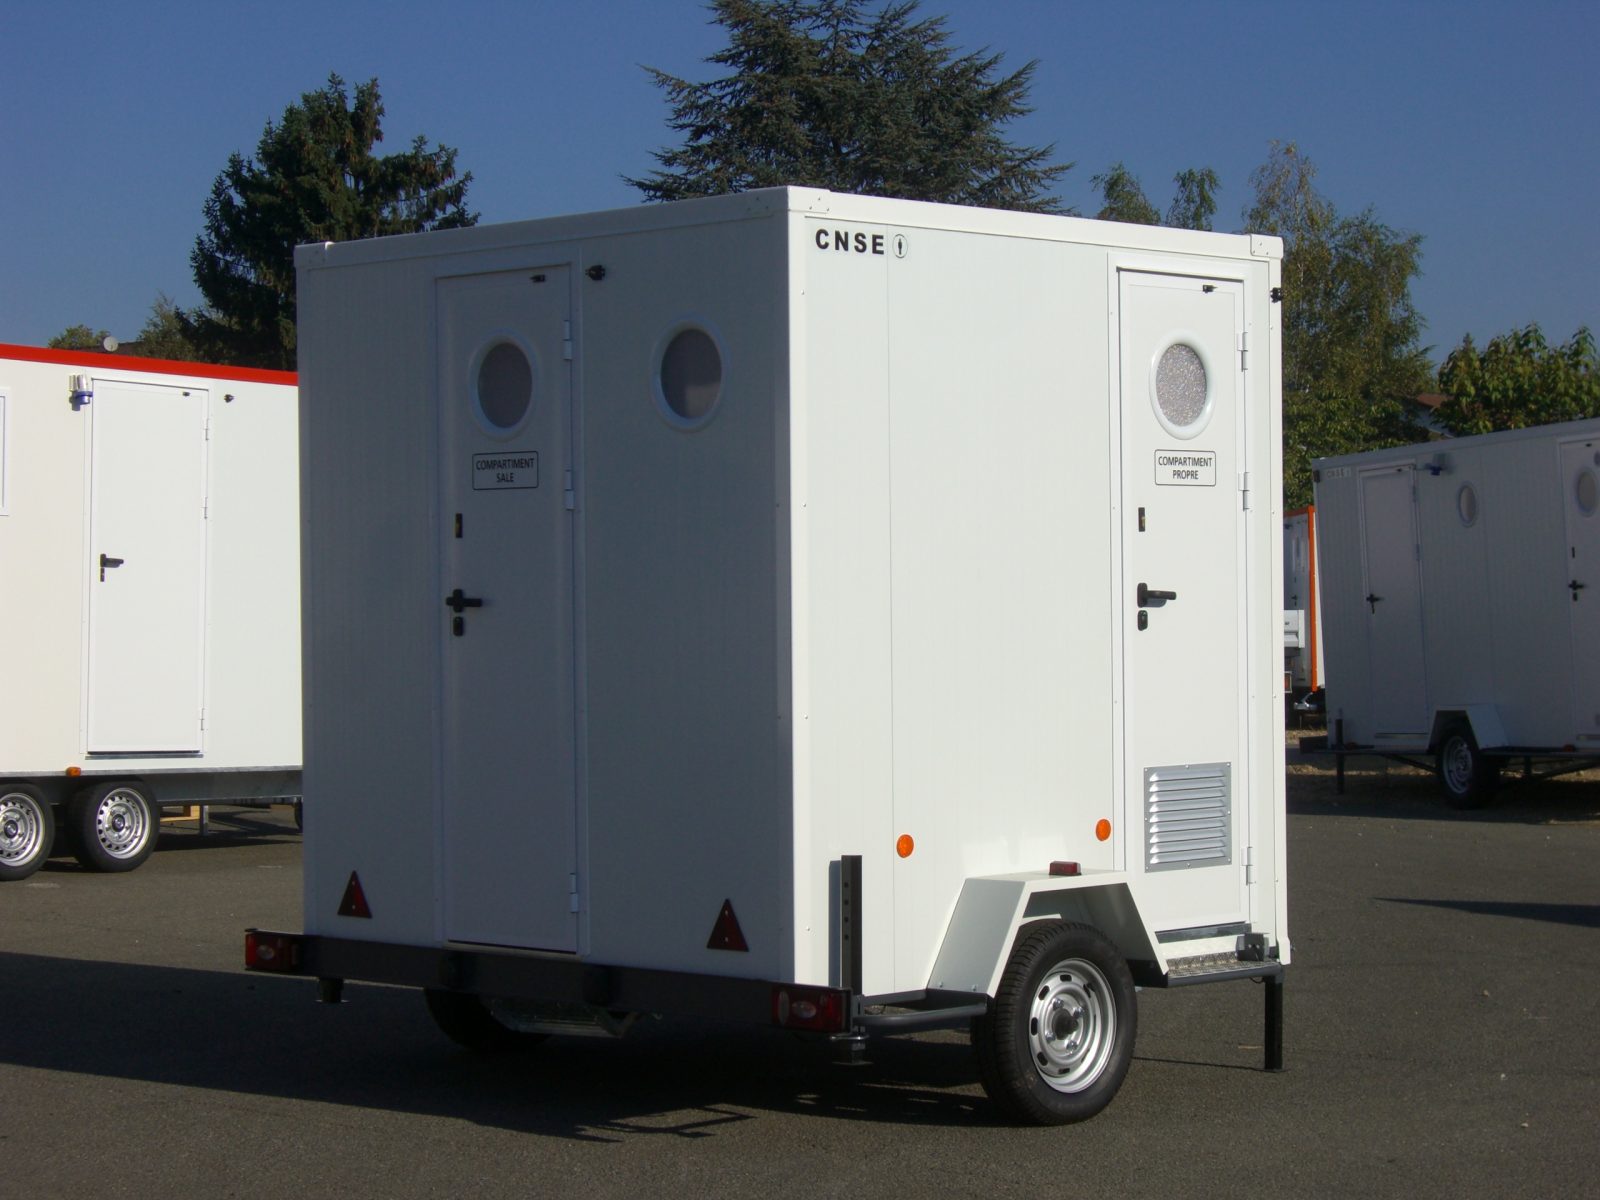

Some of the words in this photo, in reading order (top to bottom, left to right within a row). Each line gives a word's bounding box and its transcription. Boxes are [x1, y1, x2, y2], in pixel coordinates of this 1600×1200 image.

[815, 228, 884, 255] CNSE
[475, 457, 535, 470] COMPARTIMENT
[1158, 456, 1213, 467] COMPARTIMENT
[496, 472, 514, 483] SALE
[1172, 469, 1199, 480] PROPRE
